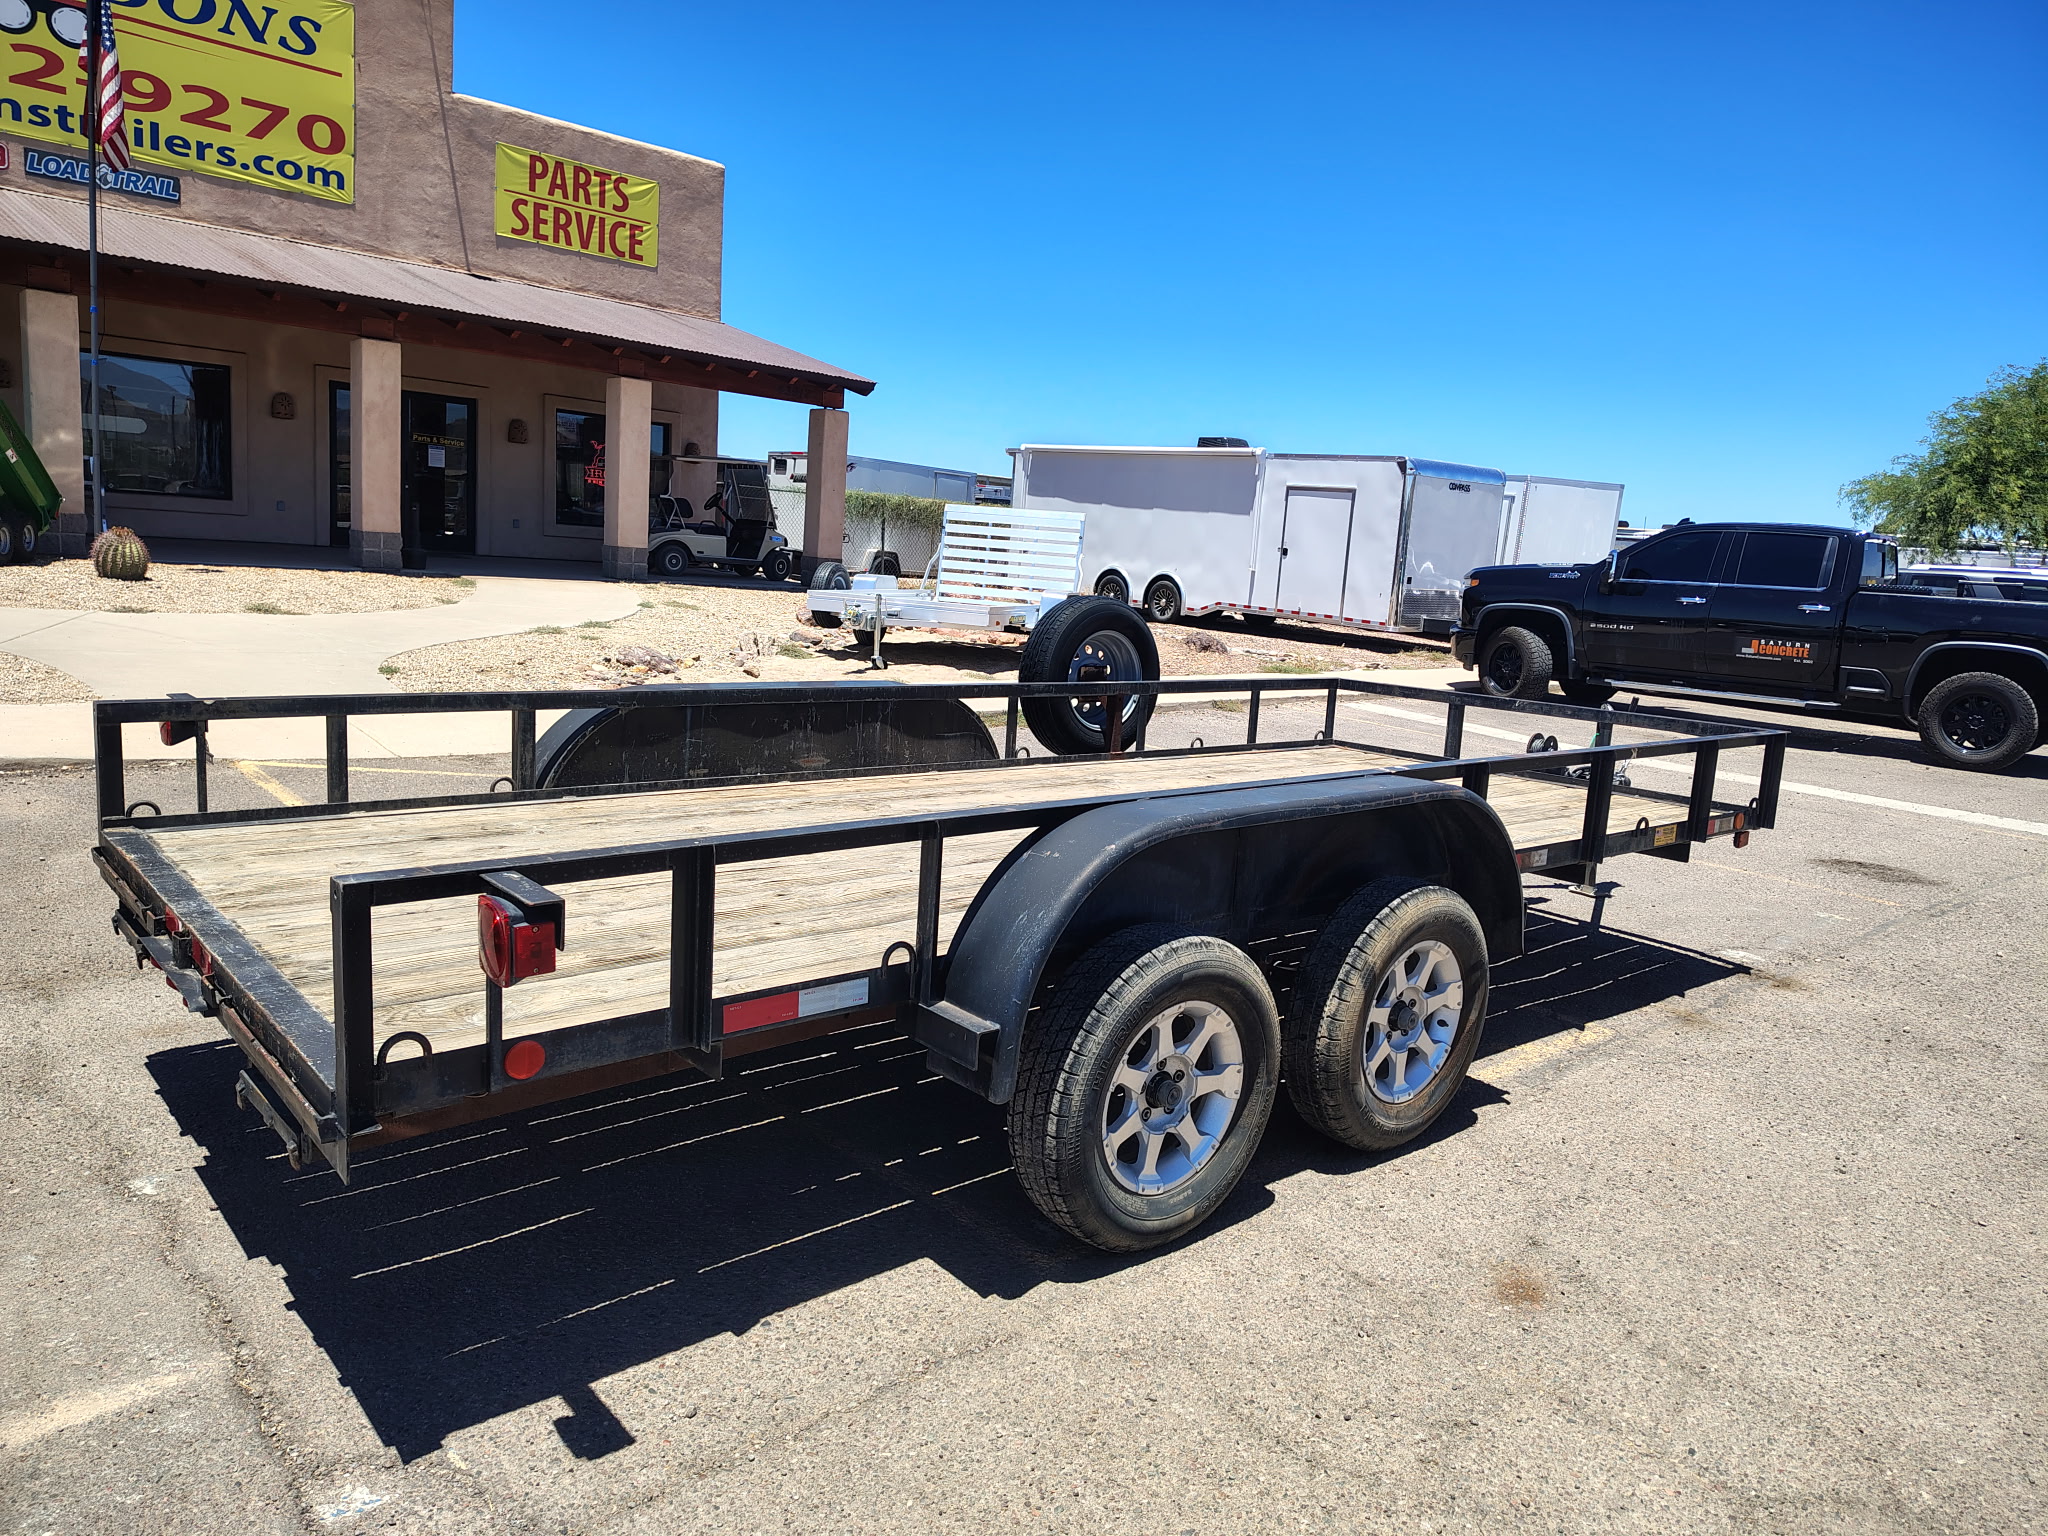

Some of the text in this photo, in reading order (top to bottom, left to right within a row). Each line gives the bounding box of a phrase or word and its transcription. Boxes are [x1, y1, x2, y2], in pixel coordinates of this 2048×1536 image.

[112, 0, 322, 56] ONS
[0, 98, 345, 190] nstilers.com
[26, 152, 179, 200] LOAD TRAIL
[529, 154, 630, 213] PARTS
[510, 198, 644, 262] SERVICE
[413, 434, 431, 442] Parts
[440, 437, 465, 447] Service
[1449, 483, 1470, 492] COMPASS
[1760, 639, 1811, 649] SATURN
[1760, 645, 1809, 657] CONCRETE
